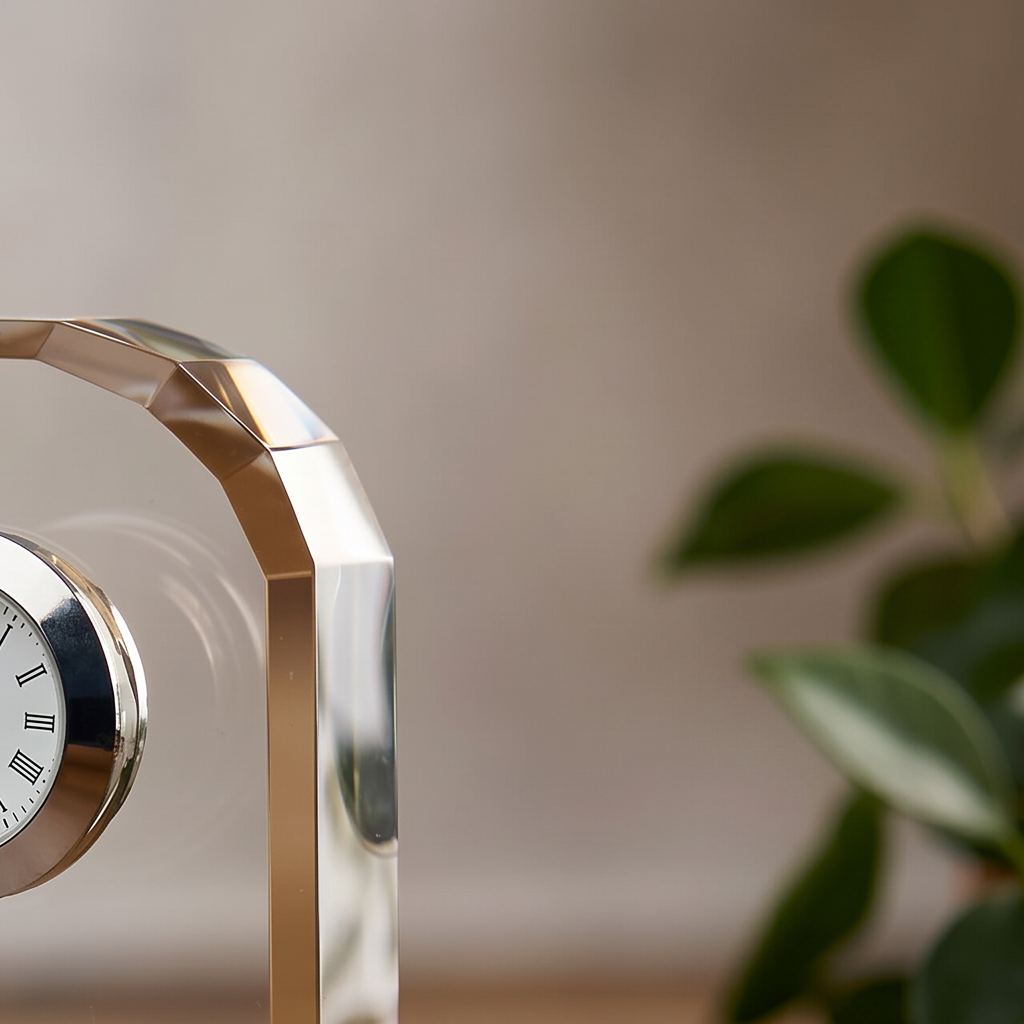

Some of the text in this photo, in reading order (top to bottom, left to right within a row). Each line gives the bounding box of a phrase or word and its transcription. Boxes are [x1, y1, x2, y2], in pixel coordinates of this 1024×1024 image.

[15, 662, 48, 688] II
[24, 711, 55, 733] III
[8, 749, 44, 786] IIII
